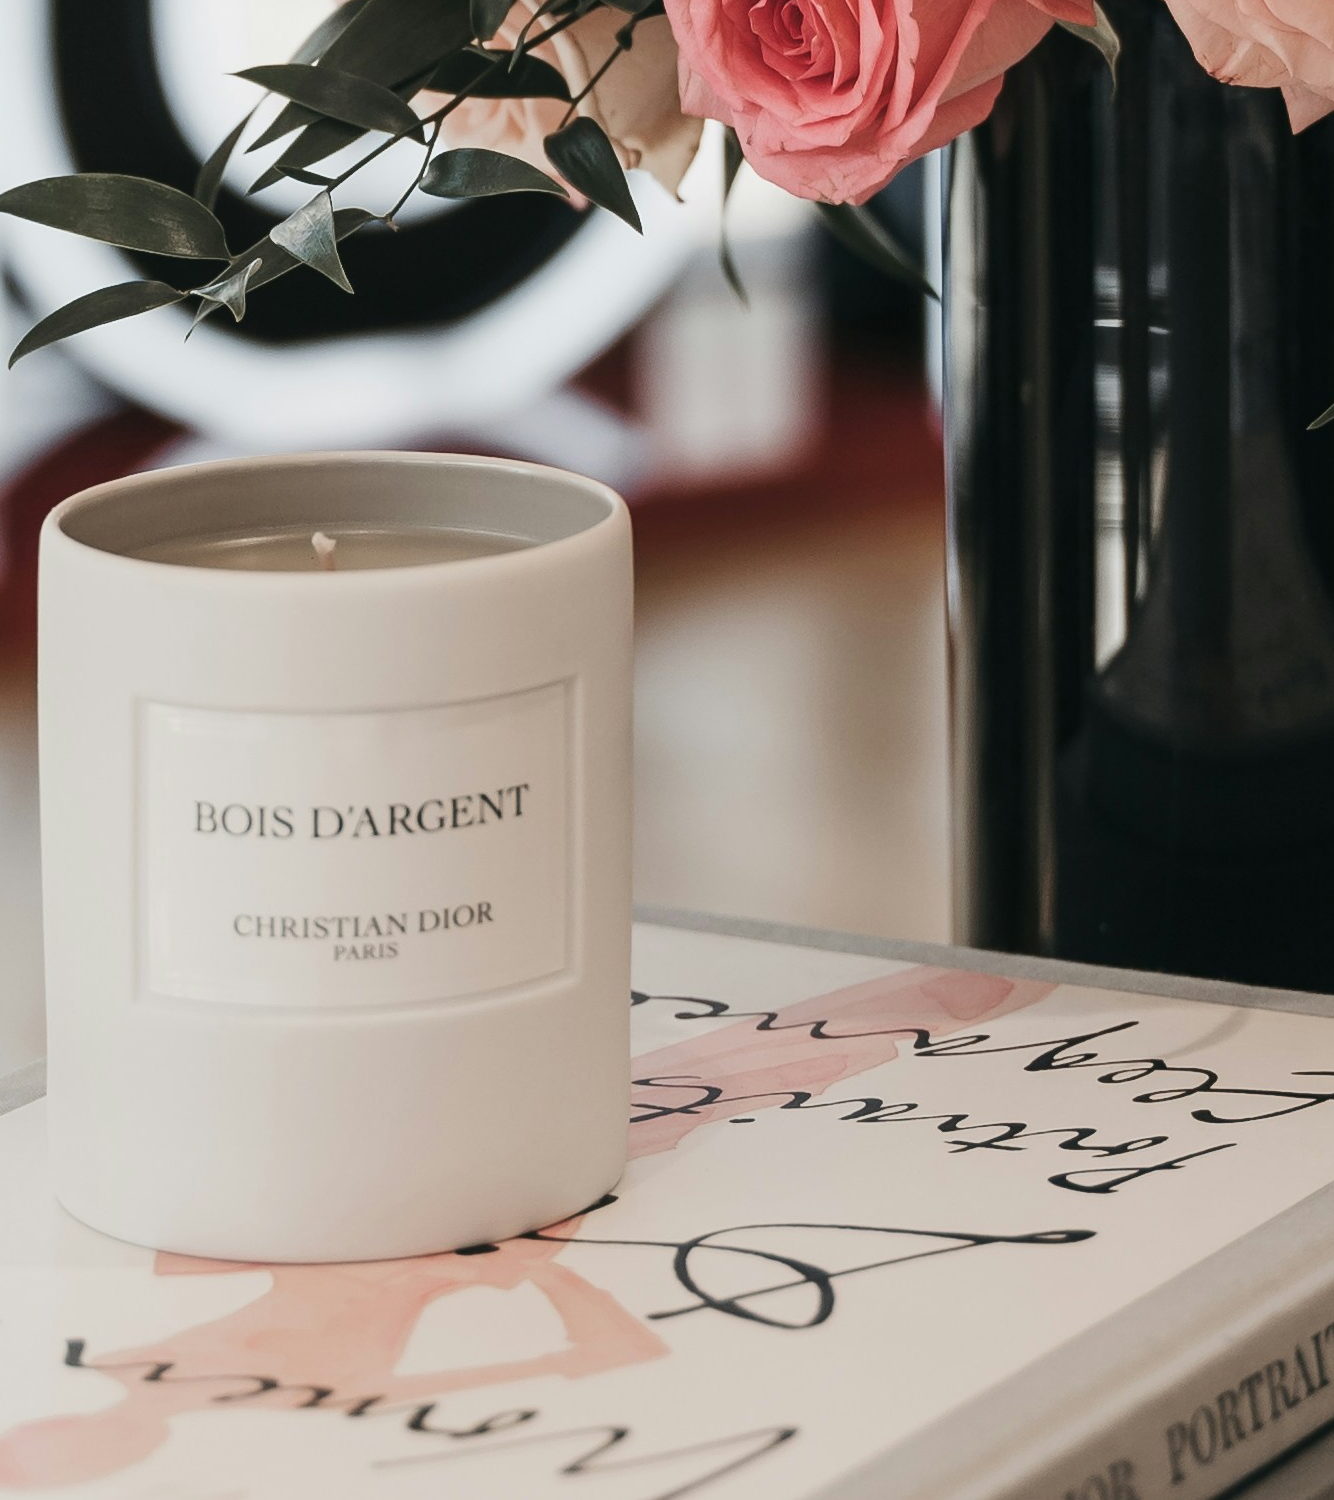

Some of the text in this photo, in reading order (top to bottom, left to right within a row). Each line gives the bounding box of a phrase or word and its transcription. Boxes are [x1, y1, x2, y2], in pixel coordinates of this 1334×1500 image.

[194, 783, 531, 839] BOIS D'ARGENT
[233, 900, 494, 940] CHRISTIAN DIOR
[333, 942, 400, 962] PARIS
